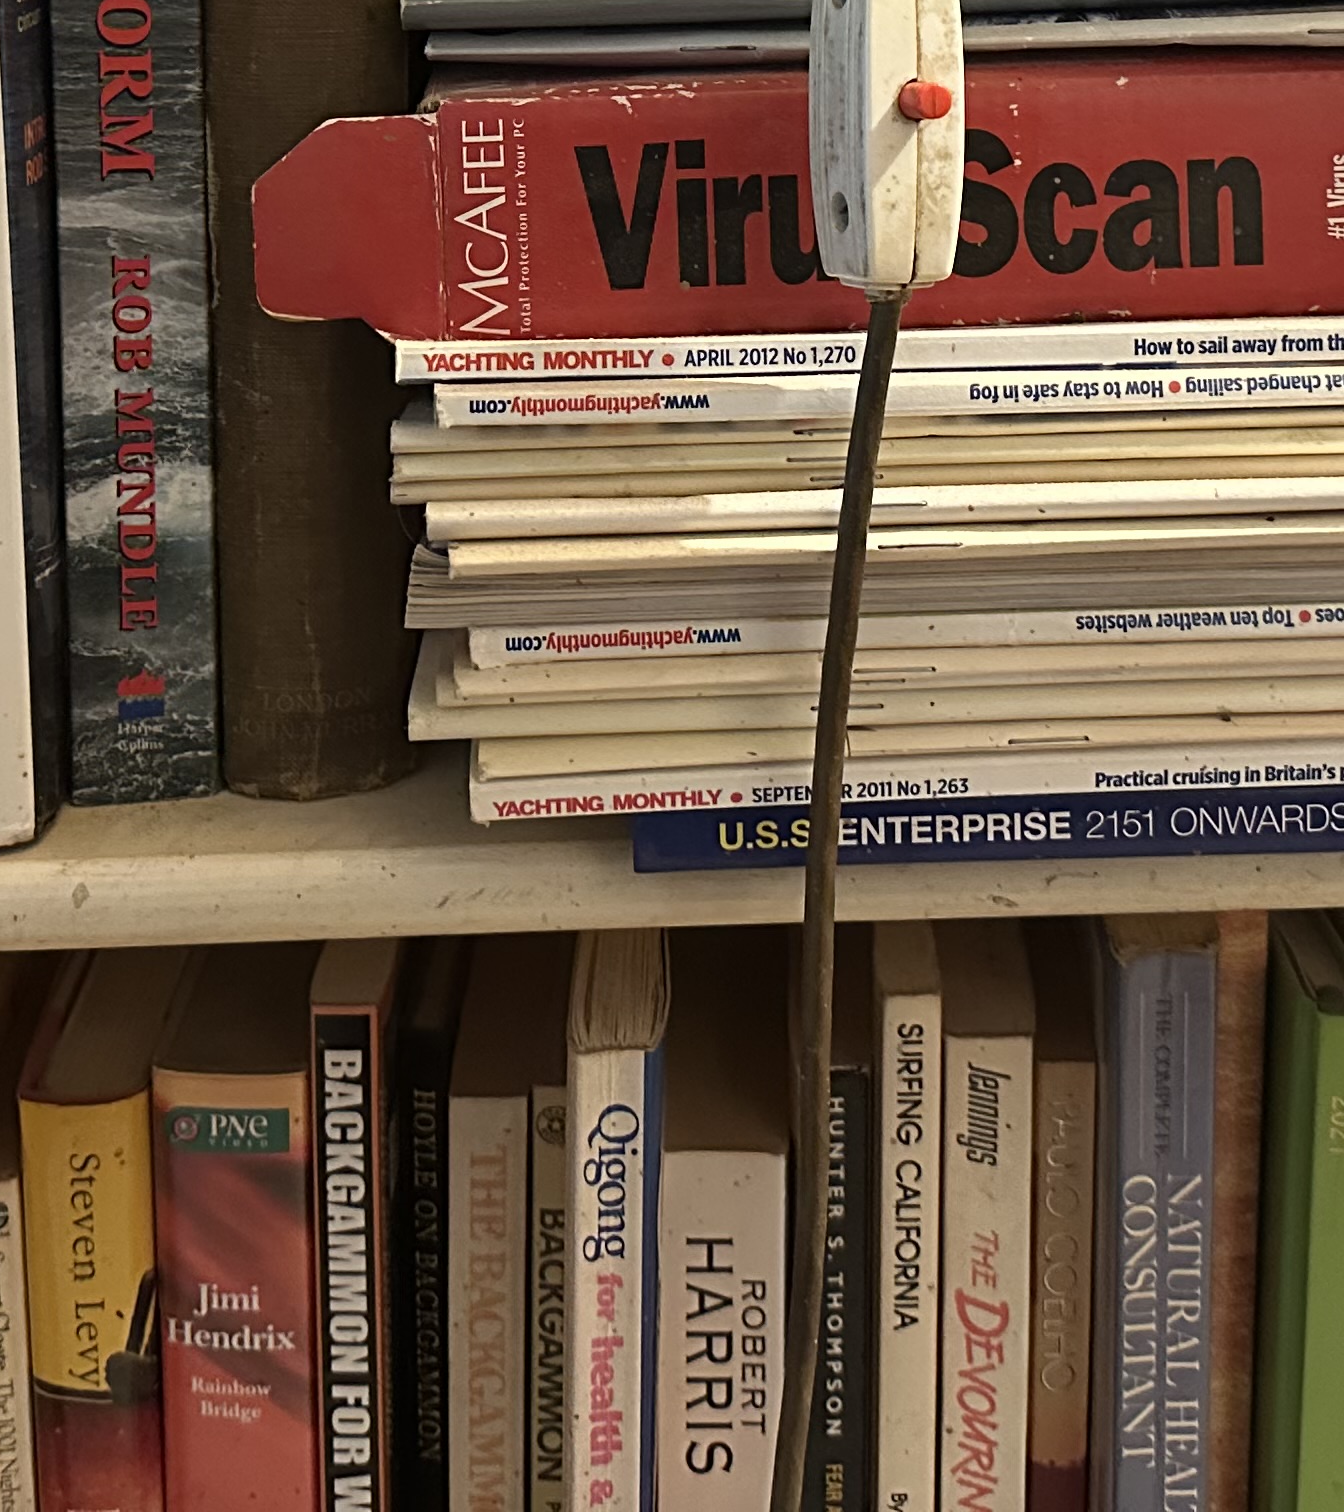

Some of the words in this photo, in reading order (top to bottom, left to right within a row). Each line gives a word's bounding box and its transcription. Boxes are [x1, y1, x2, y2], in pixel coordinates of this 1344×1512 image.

[512, 118, 525, 139] PC
[512, 144, 527, 181] Your
[514, 183, 528, 207] For
[516, 208, 531, 292] Protection
[110, 253, 154, 375] ROB
[518, 296, 533, 334] Total
[1133, 338, 1173, 357] How
[1176, 339, 1195, 356] to
[1197, 335, 1230, 355] sail
[1231, 338, 1277, 358] away
[1280, 333, 1325, 354] from
[421, 351, 535, 375] YACHTING
[543, 348, 655, 371] MONTHLY
[683, 347, 736, 369] APRIL
[738, 346, 780, 367] 2012
[782, 346, 807, 366] No
[810, 344, 857, 368] 1,270
[114, 387, 159, 633] MUNDLE
[492, 794, 604, 817] YACHTING
[612, 788, 723, 810] MONTHLY
[837, 811, 1072, 847] ENTERPRISE
[1085, 809, 1157, 839] 2151
[856, 781, 893, 799] 2011
[896, 779, 921, 797] No
[924, 778, 969, 798] 1,263
[896, 1022, 923, 1146] SURFING
[955, 1060, 1013, 1168] Jennings
[582, 1102, 640, 1263] Qigong
[828, 1095, 847, 1219] HUNTER
[68, 1151, 101, 1285] Steven
[322, 1047, 371, 1375] BACKGAMMON
[827, 1234, 846, 1262] S.
[893, 1159, 923, 1331] CALIFORNIA
[193, 1282, 261, 1319] Jimi
[596, 1271, 625, 1324] for
[970, 1228, 999, 1290] THE
[1164, 1172, 1204, 1388] NATURAL
[166, 1317, 298, 1353] Hendrix
[536, 1205, 566, 1484] BACKGAMMON
[683, 1235, 736, 1476] HARRIS
[739, 1276, 768, 1435] ROBERT
[825, 1270, 847, 1438] THOMPSON
[1121, 1173, 1158, 1471] CONSULTANT
[190, 1375, 272, 1398] Rainbow
[199, 1398, 263, 1423] Bridge
[330, 1382, 373, 1466] FOR
[589, 1334, 626, 1468] health
[589, 1478, 615, 1508] &
